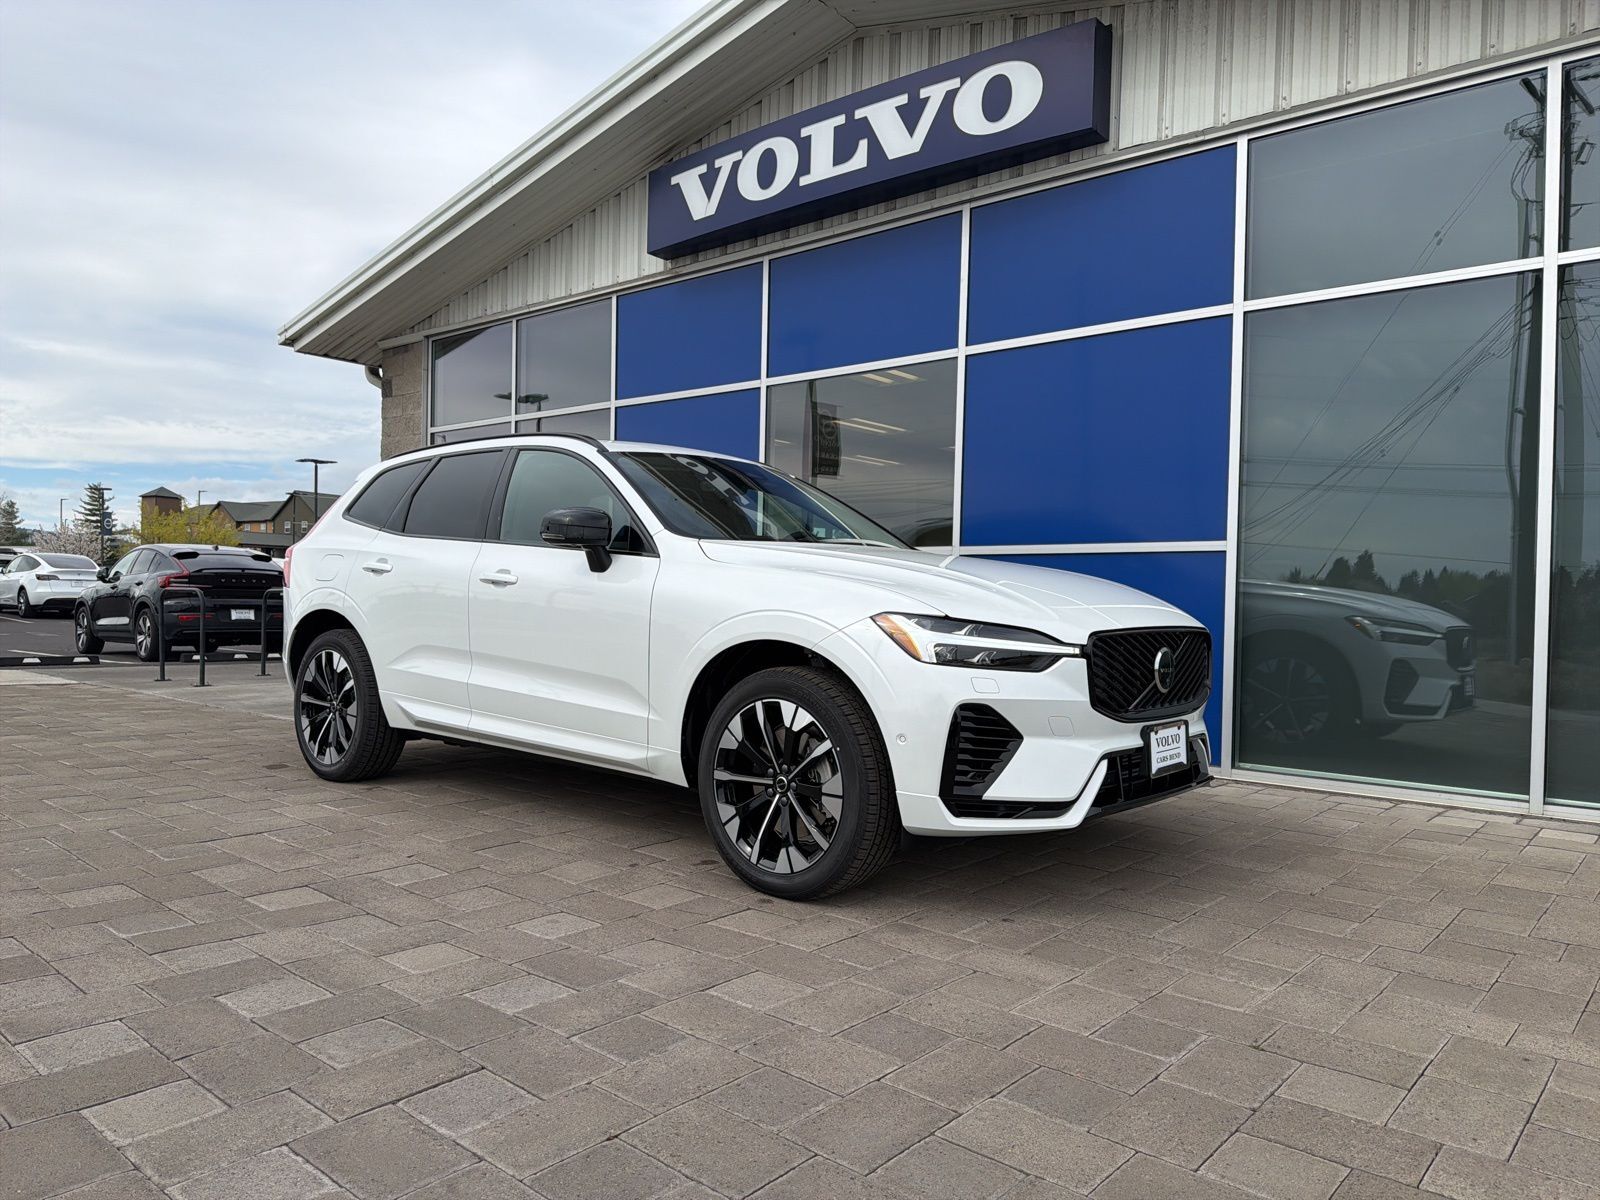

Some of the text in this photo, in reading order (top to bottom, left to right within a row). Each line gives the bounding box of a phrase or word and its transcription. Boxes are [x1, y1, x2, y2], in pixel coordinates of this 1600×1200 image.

[671, 60, 1043, 221] VOLVO
[1155, 733, 1180, 748] VOLVO
[1156, 752, 1181, 764] CARS BEND
